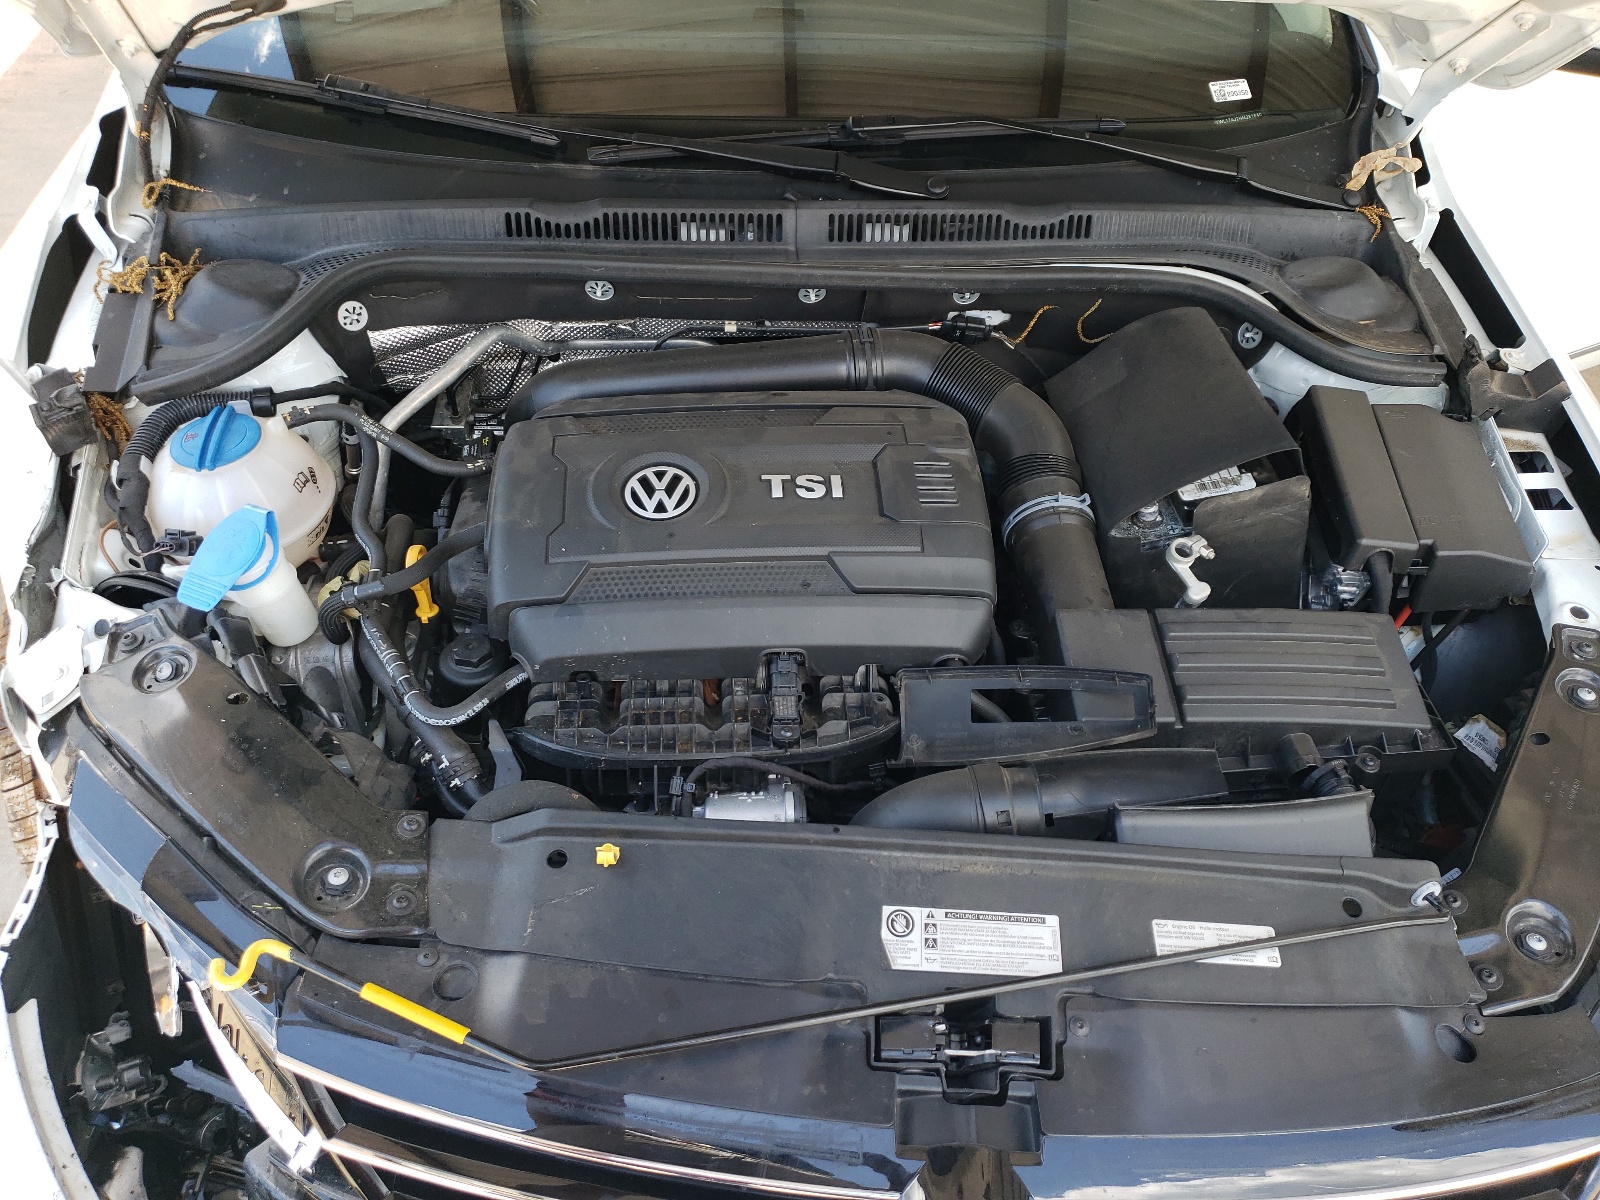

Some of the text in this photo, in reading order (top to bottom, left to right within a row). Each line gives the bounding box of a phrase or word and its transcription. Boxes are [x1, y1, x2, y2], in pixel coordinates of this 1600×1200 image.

[624, 466, 697, 519] VW
[760, 474, 844, 499] TSI
[947, 912, 1045, 924] ACHTUNG! WARNING! ATTENTION!
